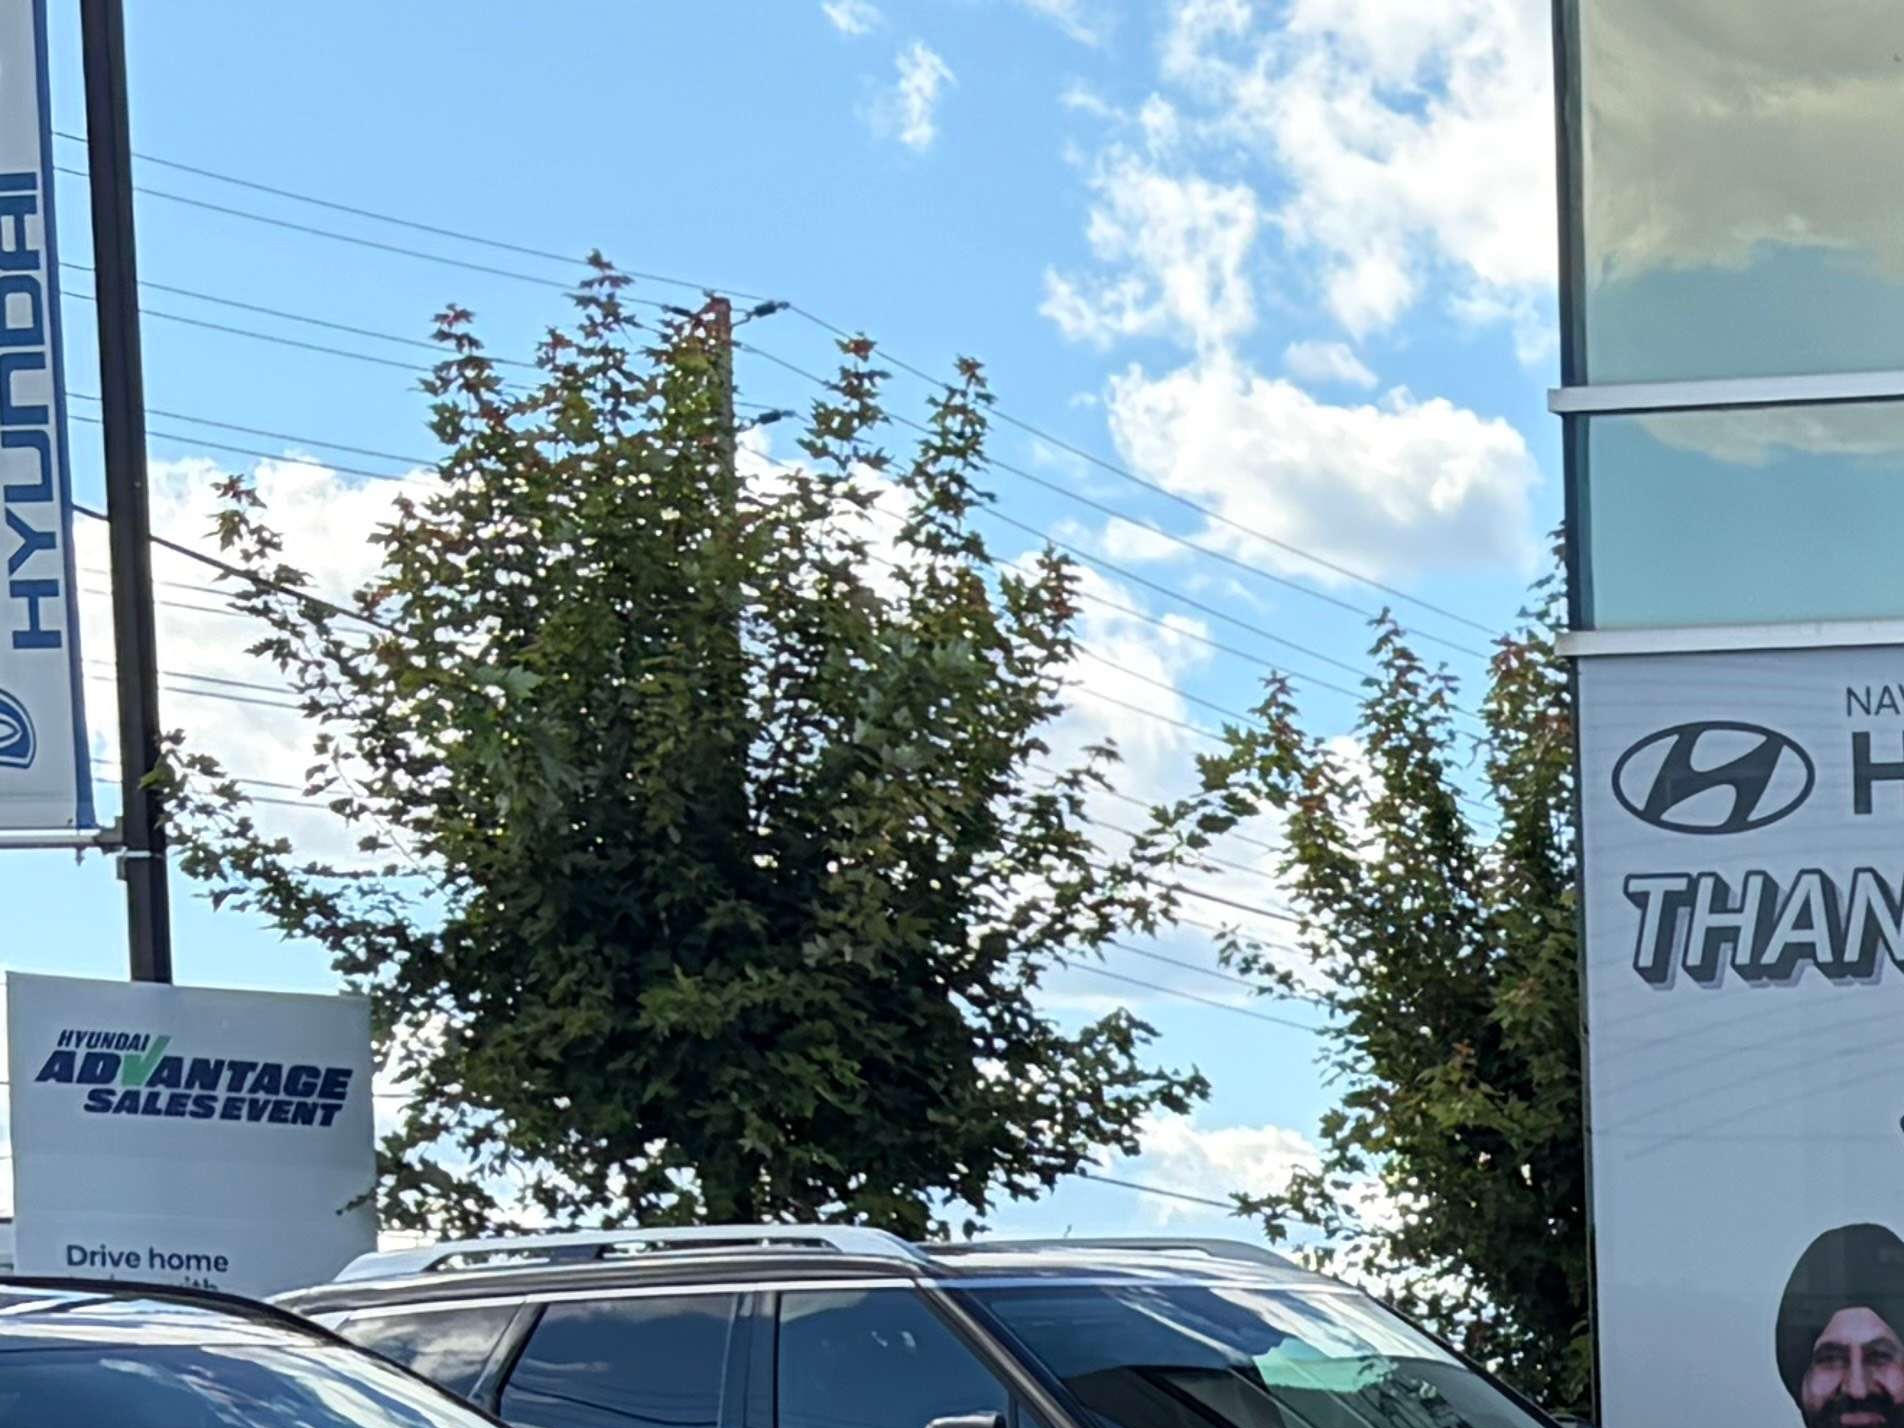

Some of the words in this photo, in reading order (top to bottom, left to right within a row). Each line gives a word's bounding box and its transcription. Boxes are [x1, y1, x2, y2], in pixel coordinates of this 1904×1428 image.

[58, 1029, 150, 1051] HYUNDAI
[35, 1038, 353, 1100] ADVANTAGE
[83, 1089, 216, 1120] SALES
[220, 1100, 343, 1127] EVENT
[66, 1243, 141, 1269] Drive
[148, 1246, 229, 1273] home
